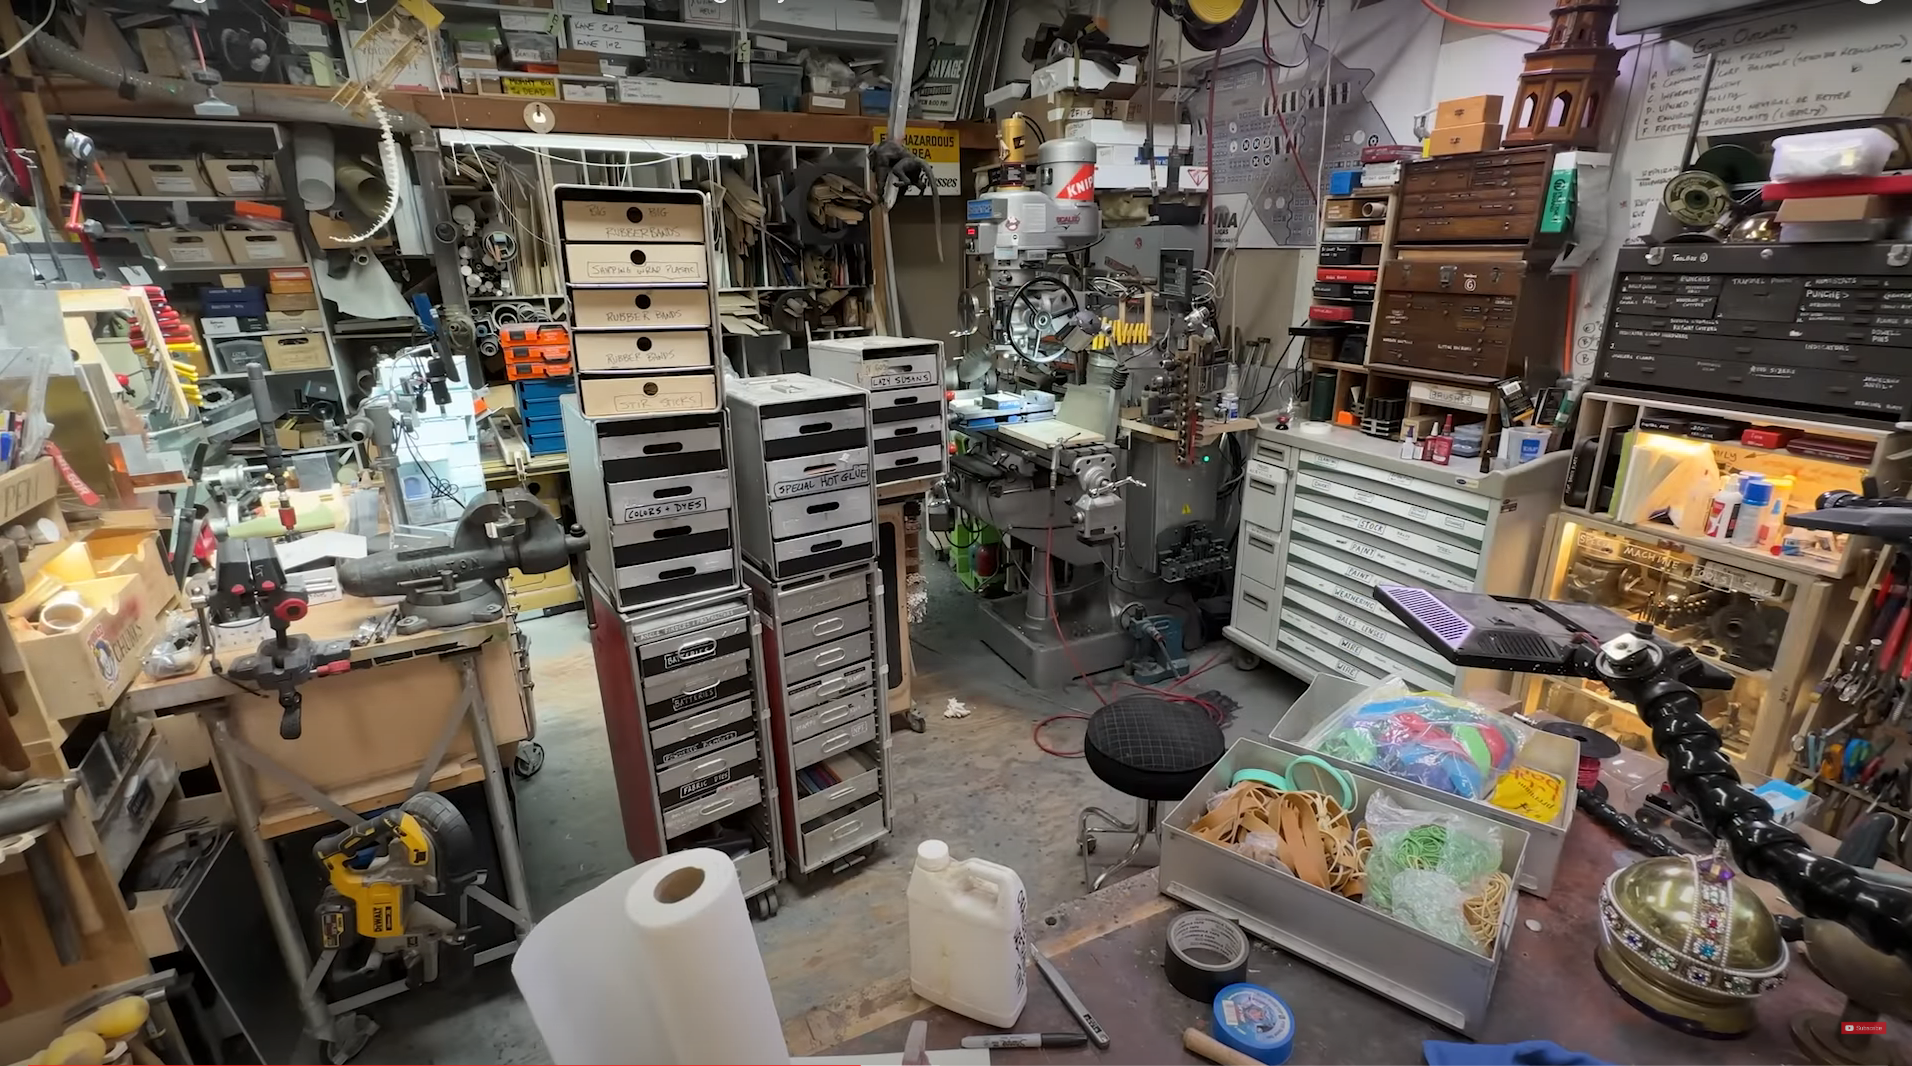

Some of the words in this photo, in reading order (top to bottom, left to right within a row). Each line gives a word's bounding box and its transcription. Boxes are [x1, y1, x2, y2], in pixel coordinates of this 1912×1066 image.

[928, 59, 964, 79] SAVAGE
[522, 87, 547, 96] DEAD
[914, 134, 954, 147] HAZARDOUS
[606, 311, 651, 323] RUBBER
[655, 310, 682, 319] BANDS
[606, 352, 641, 364] RUBBER
[647, 350, 675, 361] BANDS
[872, 377, 891, 387] LAZY
[894, 374, 929, 385] SUSANS
[1430, 390, 1472, 406] BRUSHES
[821, 474, 839, 487] HOT
[841, 469, 867, 482] GLUE
[628, 506, 661, 519] COLORS
[674, 500, 702, 512] DYES
[1360, 520, 1384, 533] STOCK
[1351, 544, 1374, 557] PAINT
[1624, 545, 1679, 569] MACHINE
[1348, 567, 1369, 580] PAINT
[1693, 565, 1728, 585] TOOLS
[1334, 588, 1375, 610] WEATHERING
[1337, 614, 1357, 627] BALLS
[1361, 625, 1384, 640] LENSES
[640, 630, 661, 641] ANGLE
[1341, 639, 1361, 653] WIRE
[1337, 661, 1356, 675] WIRE
[674, 688, 714, 708] BATTERIES
[683, 778, 708, 795] FABRIC
[713, 772, 729, 783] DYES
